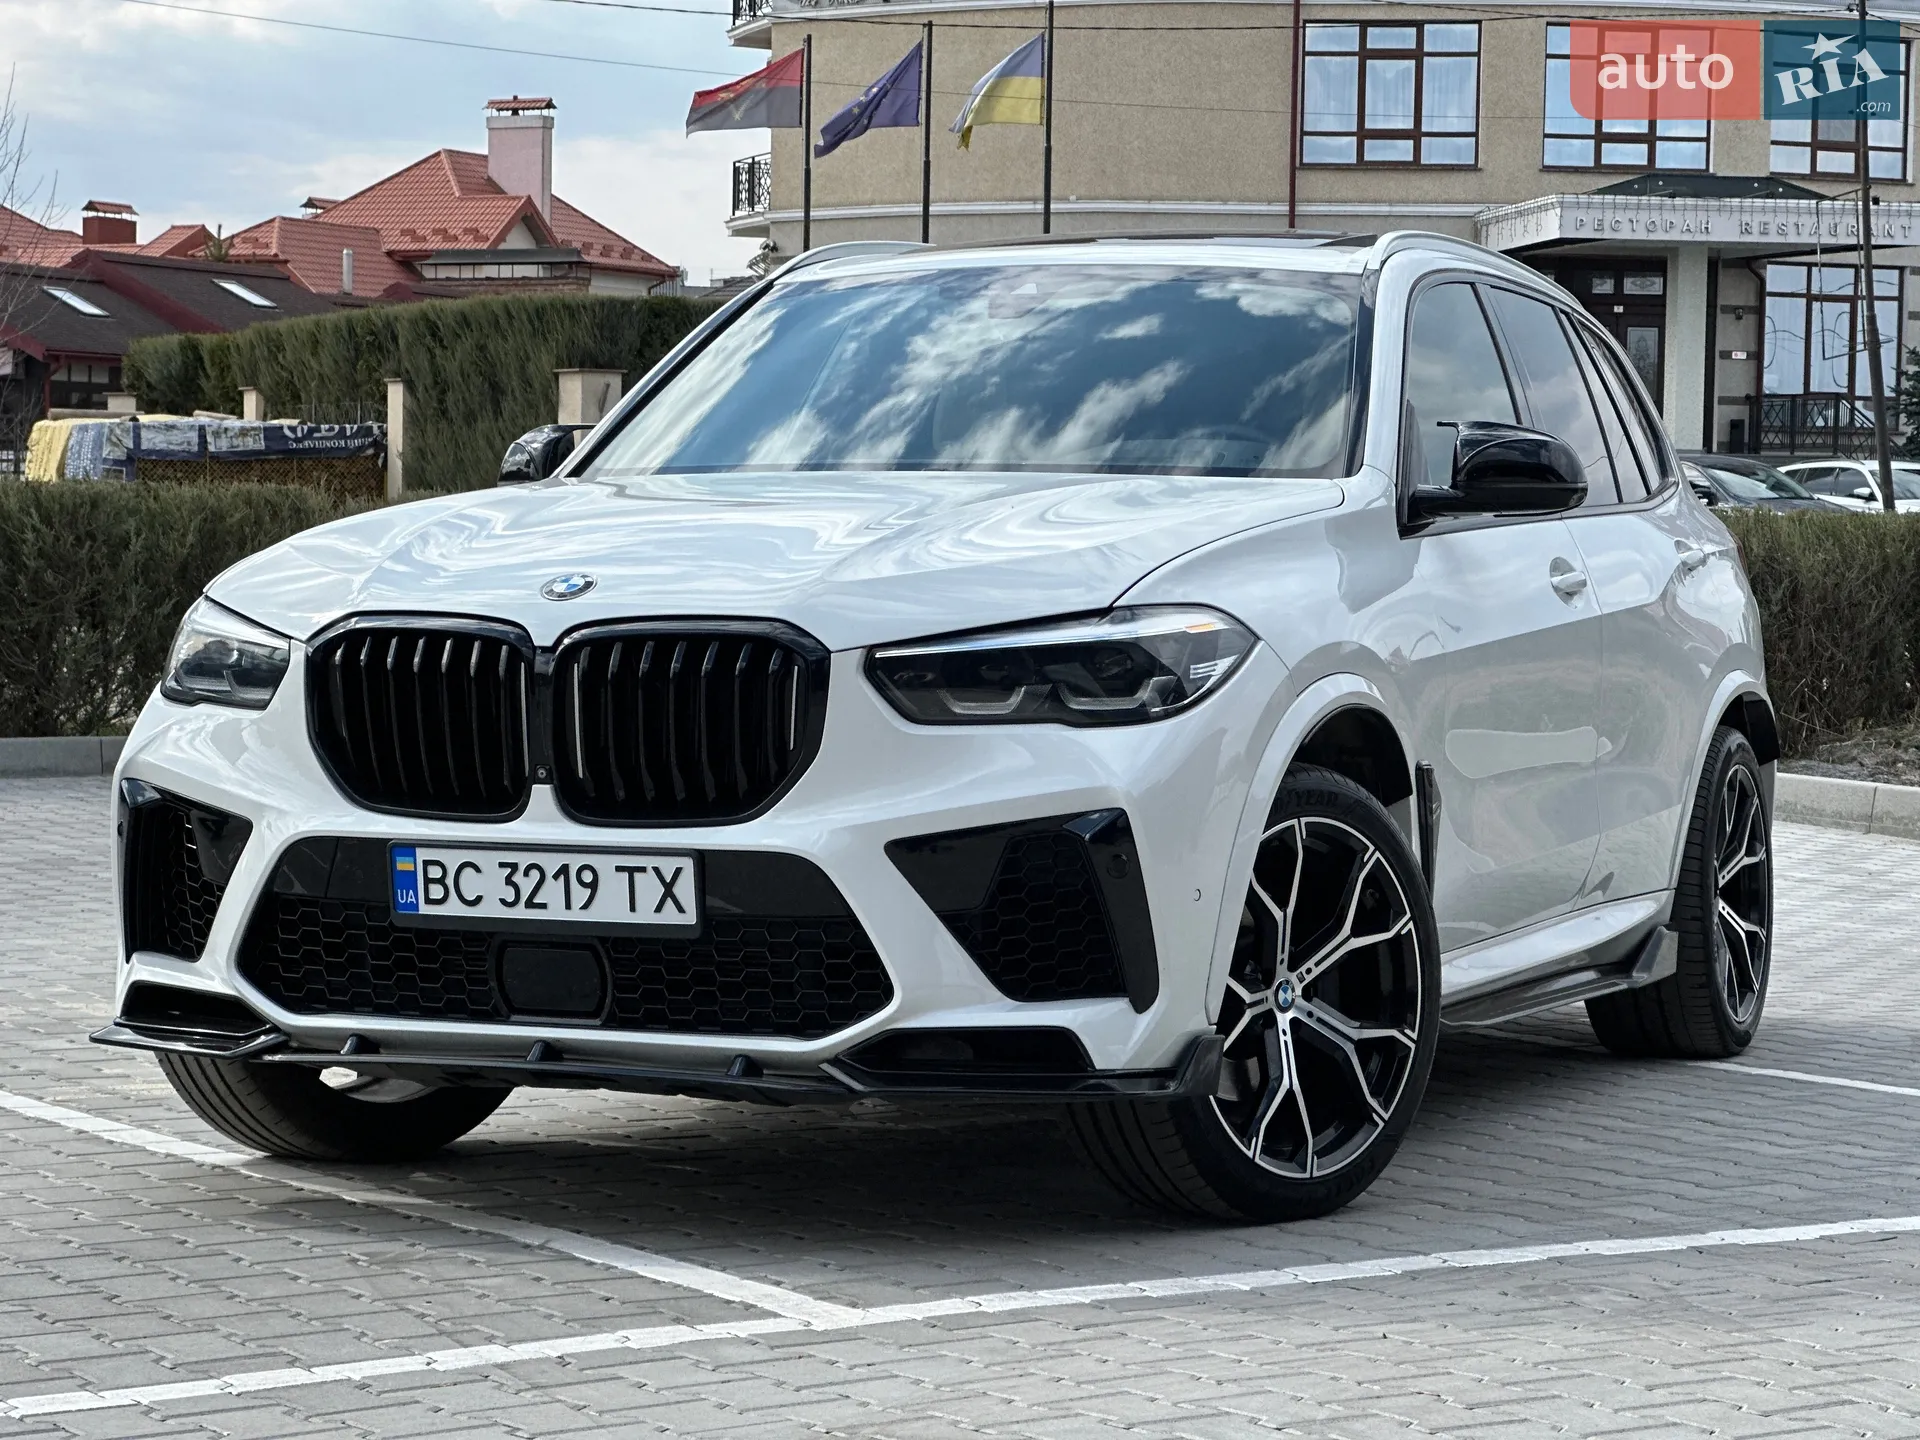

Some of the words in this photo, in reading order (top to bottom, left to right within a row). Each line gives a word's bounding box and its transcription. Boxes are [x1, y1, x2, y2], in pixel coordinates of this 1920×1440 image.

[1576, 216, 1712, 234] РЕСТОРАН
[421, 859, 484, 908] BC
[498, 861, 599, 910] 3219
[615, 865, 686, 914] TX
[397, 889, 416, 904] UA
